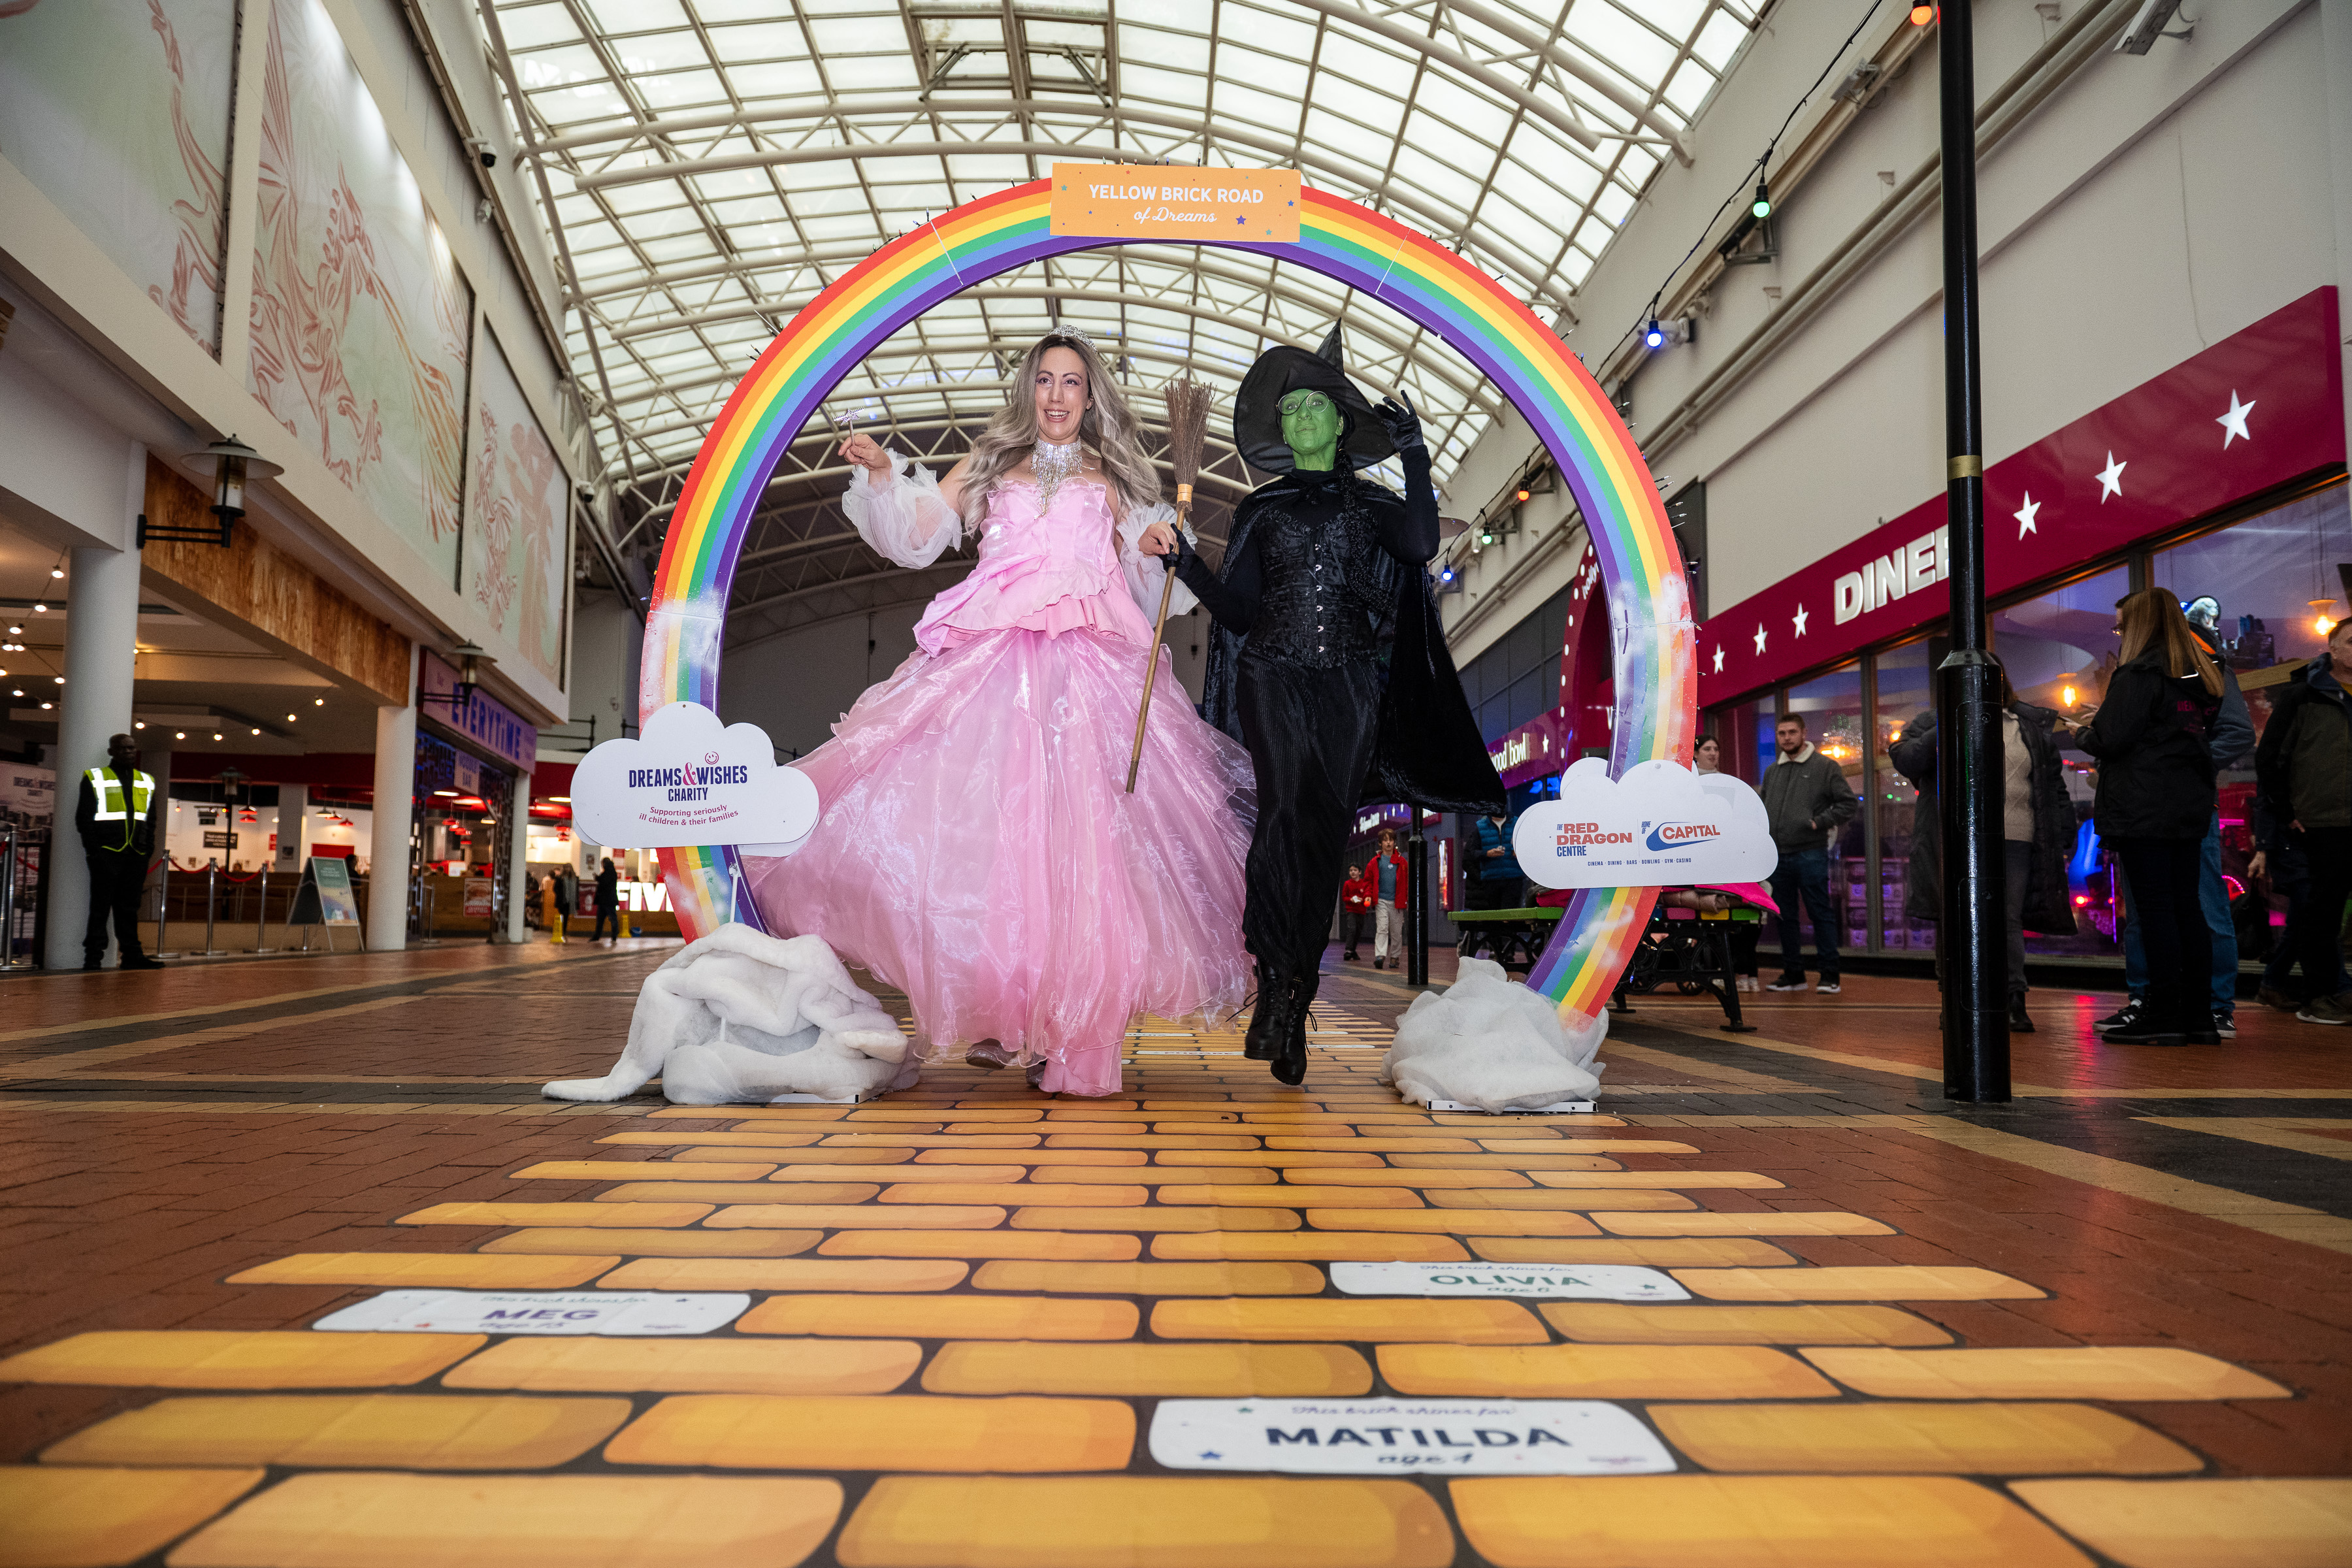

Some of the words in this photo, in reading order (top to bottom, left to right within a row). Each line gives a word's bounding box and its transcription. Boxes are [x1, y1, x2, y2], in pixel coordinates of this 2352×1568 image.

[1088, 184, 1157, 201] YELLOW
[1161, 187, 1212, 203] BRICK
[1217, 188, 1264, 204] ROAD
[1134, 206, 1151, 224] of
[1152, 206, 1217, 223] Dreams
[1509, 732, 1526, 766] bowl
[668, 787, 709, 802] CHARITY
[648, 816, 679, 825] children
[709, 810, 738, 823] families
[650, 806, 691, 817] Supporting
[693, 804, 727, 815] seriously
[1563, 823, 1599, 834] RED
[1663, 825, 1720, 840] CAPITAL
[1557, 832, 1632, 845] DRAGON
[1557, 845, 1586, 857] CENTRE
[1429, 1275, 1593, 1287] OLIVIA
[482, 1309, 600, 1320] MEG
[1265, 1427, 1574, 1447] MATILDA
[1377, 1453, 1446, 1467] age
